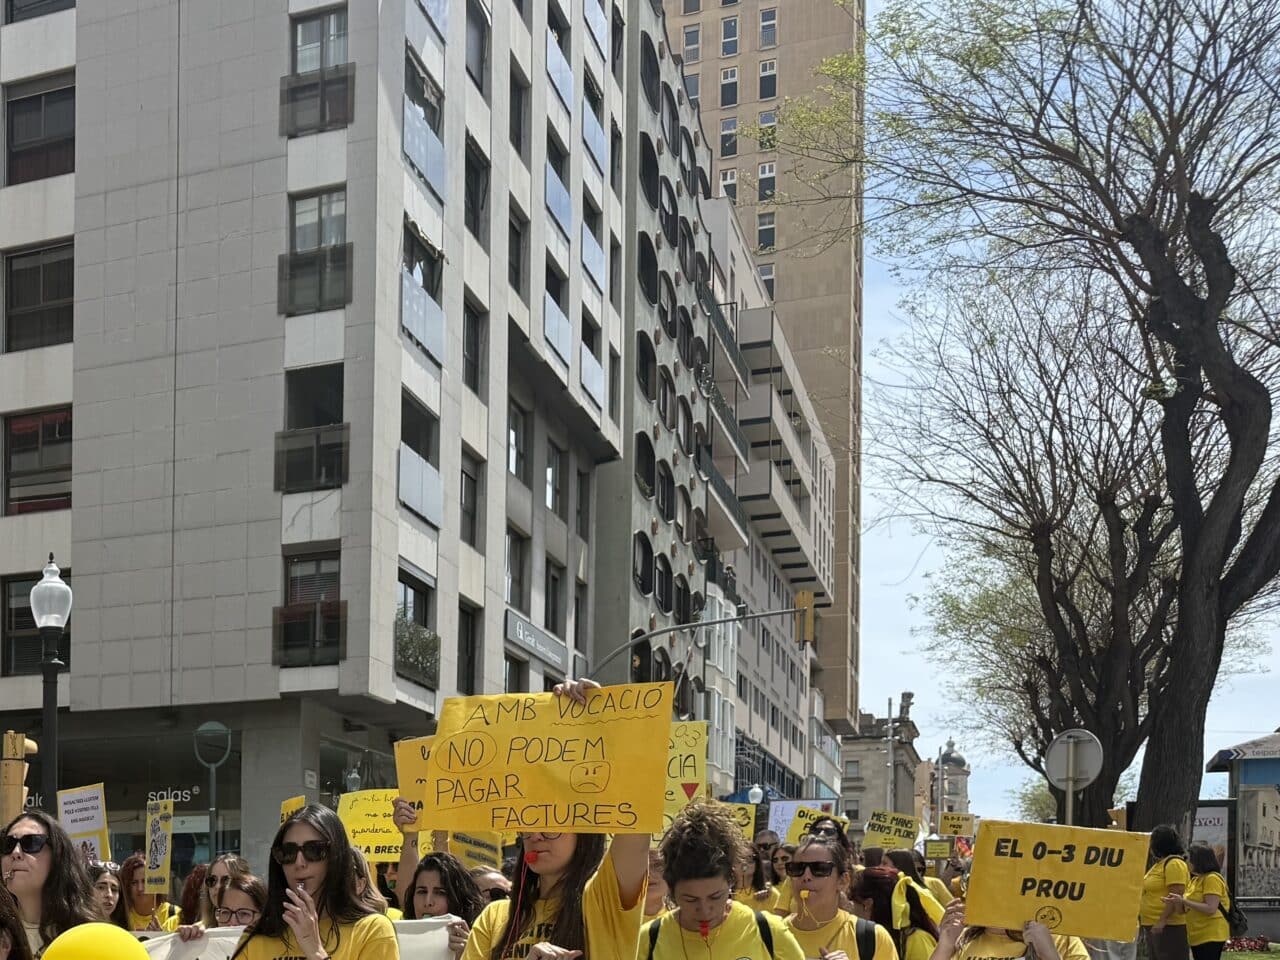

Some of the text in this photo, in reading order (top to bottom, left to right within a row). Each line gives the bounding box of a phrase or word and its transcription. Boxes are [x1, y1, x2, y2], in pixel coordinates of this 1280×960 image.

[462, 683, 667, 729] AMB VOCACIÓ
[447, 737, 485, 770] NO
[506, 735, 606, 765] PODEM
[147, 787, 191, 803] salas
[436, 773, 524, 806] PAGAR
[491, 803, 638, 829] FACTURES
[995, 838, 1125, 868] EL 0-3 DIU
[1021, 877, 1086, 901] PROU
